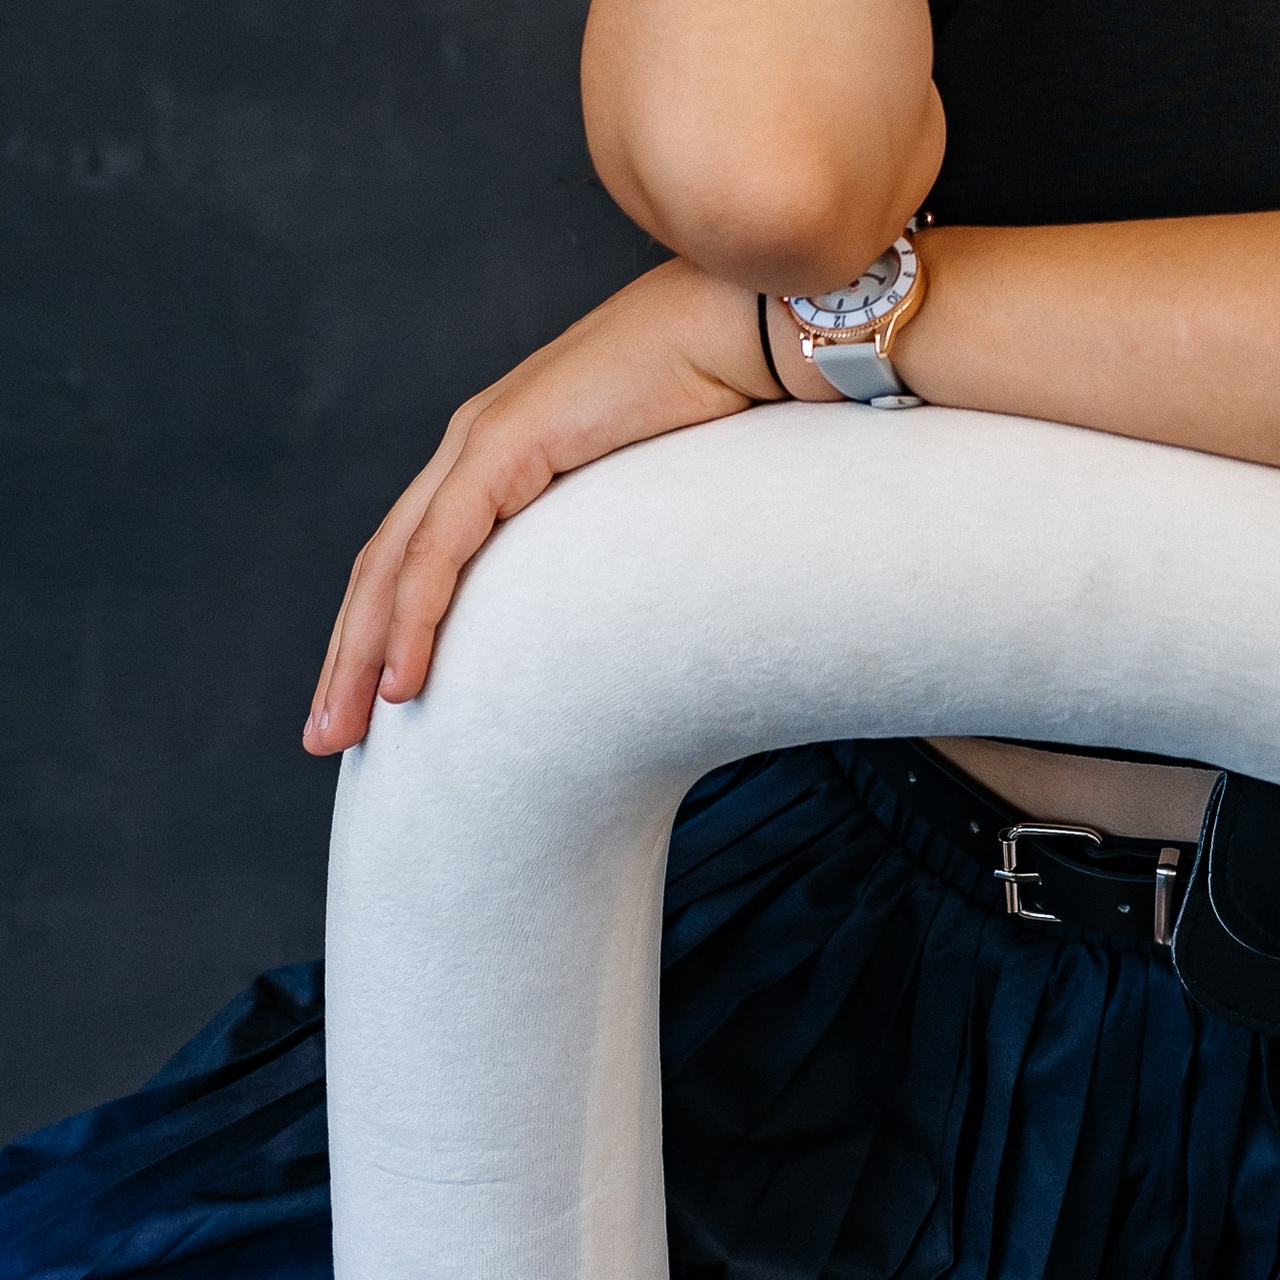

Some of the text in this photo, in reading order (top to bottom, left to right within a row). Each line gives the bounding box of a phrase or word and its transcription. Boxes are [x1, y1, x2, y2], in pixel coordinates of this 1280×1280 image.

[887, 291, 903, 305] 10
[864, 308, 876, 321] 11
[833, 315, 847, 328] 12
